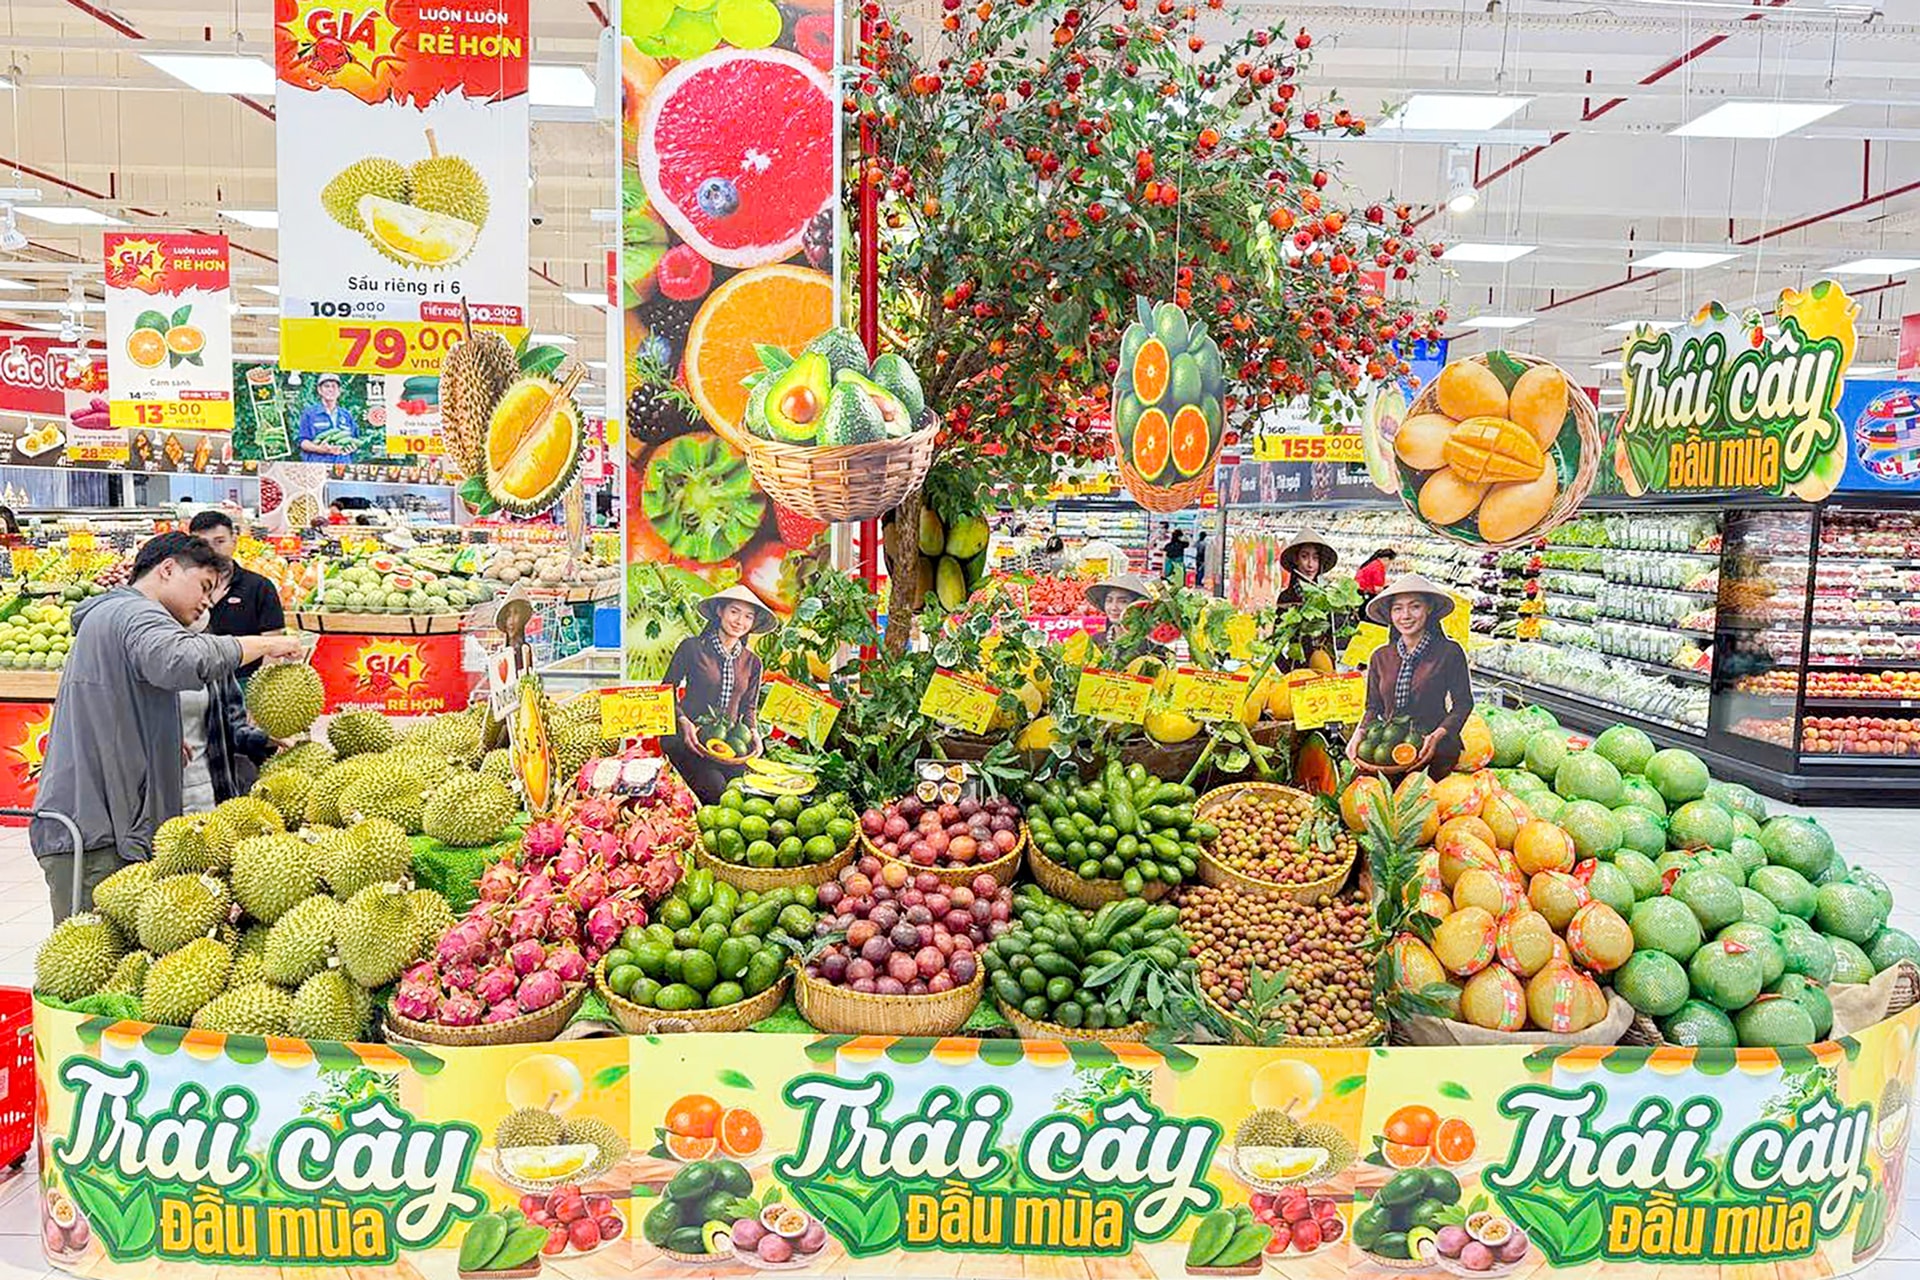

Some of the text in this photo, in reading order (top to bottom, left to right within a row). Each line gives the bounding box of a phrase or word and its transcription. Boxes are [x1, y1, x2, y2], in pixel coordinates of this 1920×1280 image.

[307, 9, 380, 50] GIÁ
[419, 9, 509, 25] LUÔN LUÔN
[418, 26, 522, 58] RẺ HƠN
[120, 249, 155, 269] GIÁ
[173, 247, 219, 255] LUÔN LUÔN
[174, 256, 226, 271] RẺ HƠN
[384, 278, 428, 295] riêng
[451, 281, 461, 294] 6
[310, 301, 385, 317] 109.000
[338, 327, 464, 369] 79.00
[134, 403, 201, 424] 13.500
[1624, 330, 1836, 472] Trái cây
[1281, 438, 1363, 458] 155.000
[1669, 428, 1780, 489] Đầu mùa
[366, 654, 412, 678] GIÁ
[388, 695, 409, 711] RẺ
[411, 698, 444, 711] HƠN
[58, 1064, 478, 1243] Trái cây
[782, 1077, 1214, 1235] Trái cây
[1491, 1088, 1868, 1227] Trái cây
[161, 1187, 387, 1258] Đầu mùa
[905, 1181, 1125, 1249] Đầu mùa
[1608, 1190, 1813, 1255] Đầu mùa
